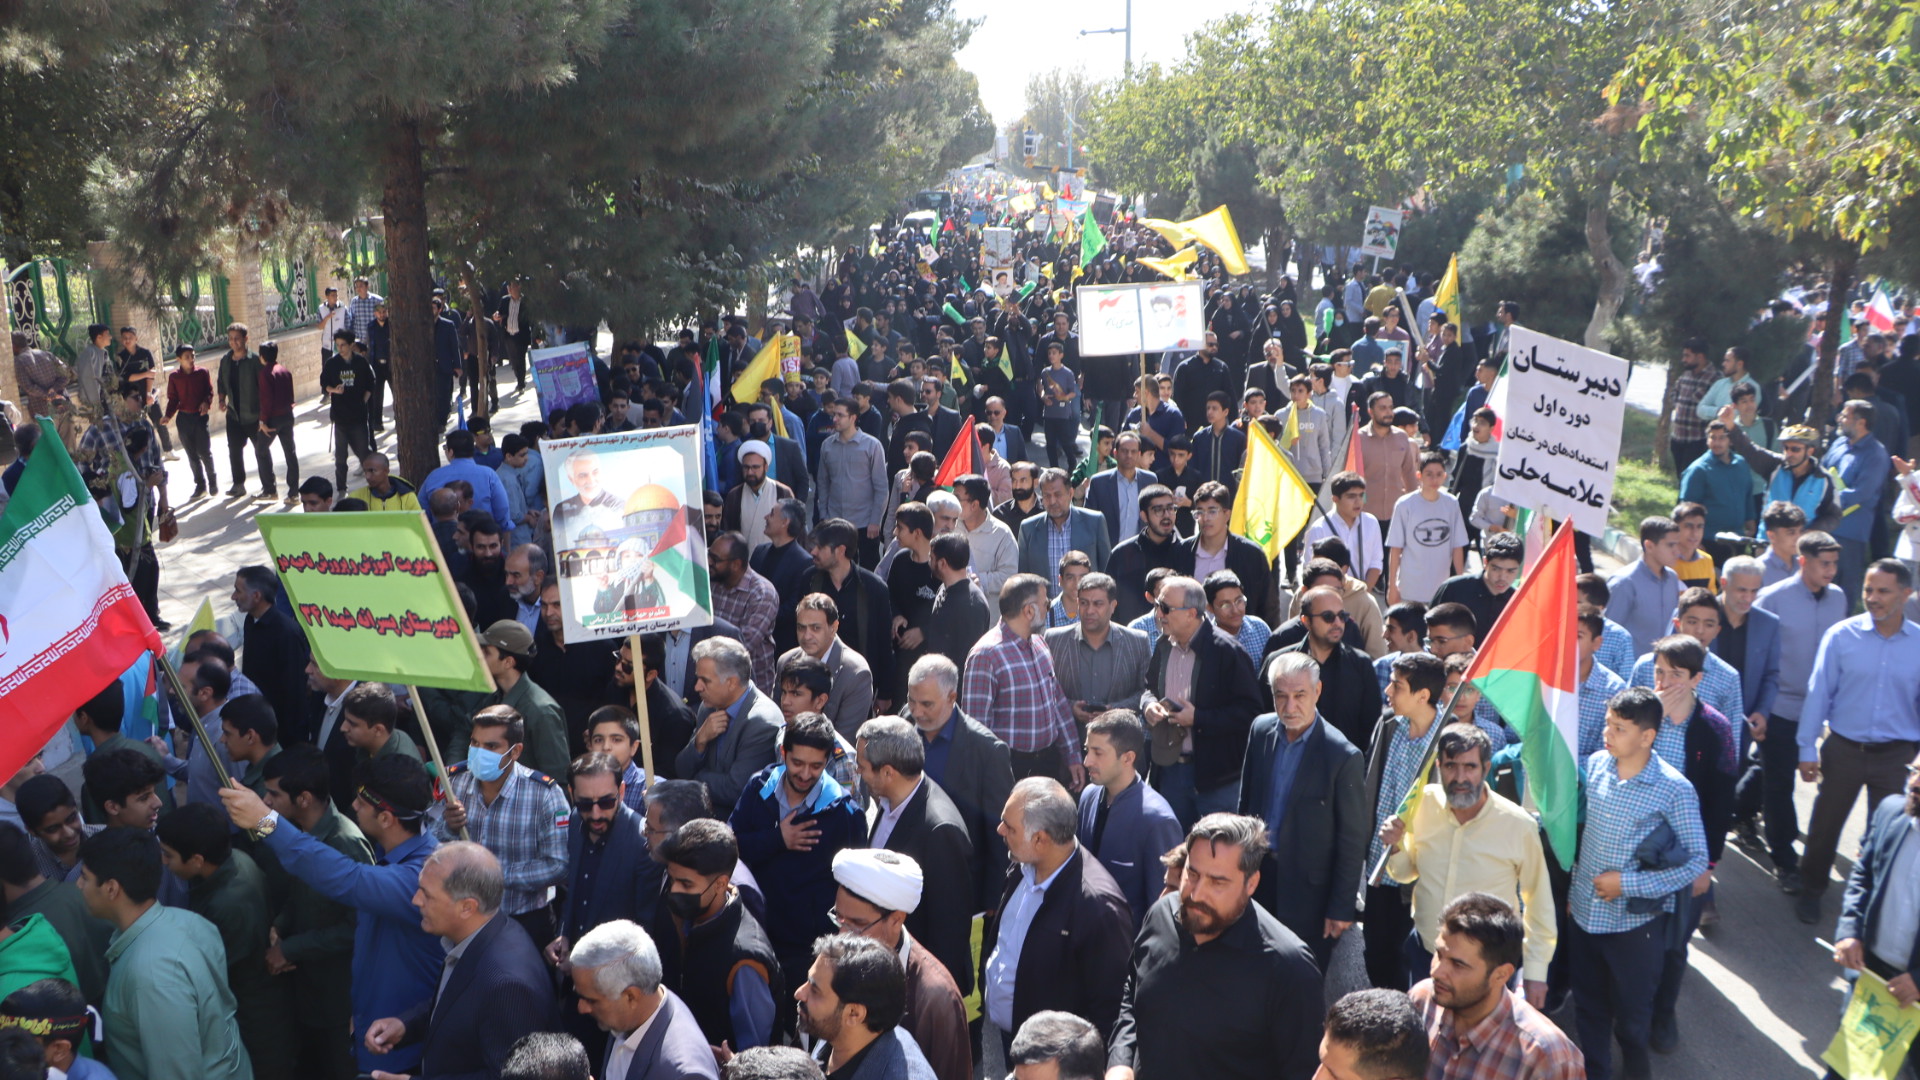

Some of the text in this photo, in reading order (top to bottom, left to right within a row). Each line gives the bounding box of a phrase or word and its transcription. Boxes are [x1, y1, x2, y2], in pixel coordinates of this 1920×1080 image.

[1512, 344, 1622, 400] دبیرستان
[1533, 394, 1591, 428] دوره اول
[1506, 426, 1609, 472] استعدادهای درخشان
[1498, 457, 1605, 508] علامه حلی
[316, 552, 352, 577] پرورش
[360, 550, 394, 576] آموزش
[394, 556, 439, 577] مدیریت
[322, 605, 357, 632] شهدا
[357, 607, 402, 638] پسرانه
[399, 609, 460, 639] دبیرستان
[608, 625, 625, 634] شهدا
[627, 623, 649, 632] پسرانه
[650, 620, 681, 631] دبیرستان
